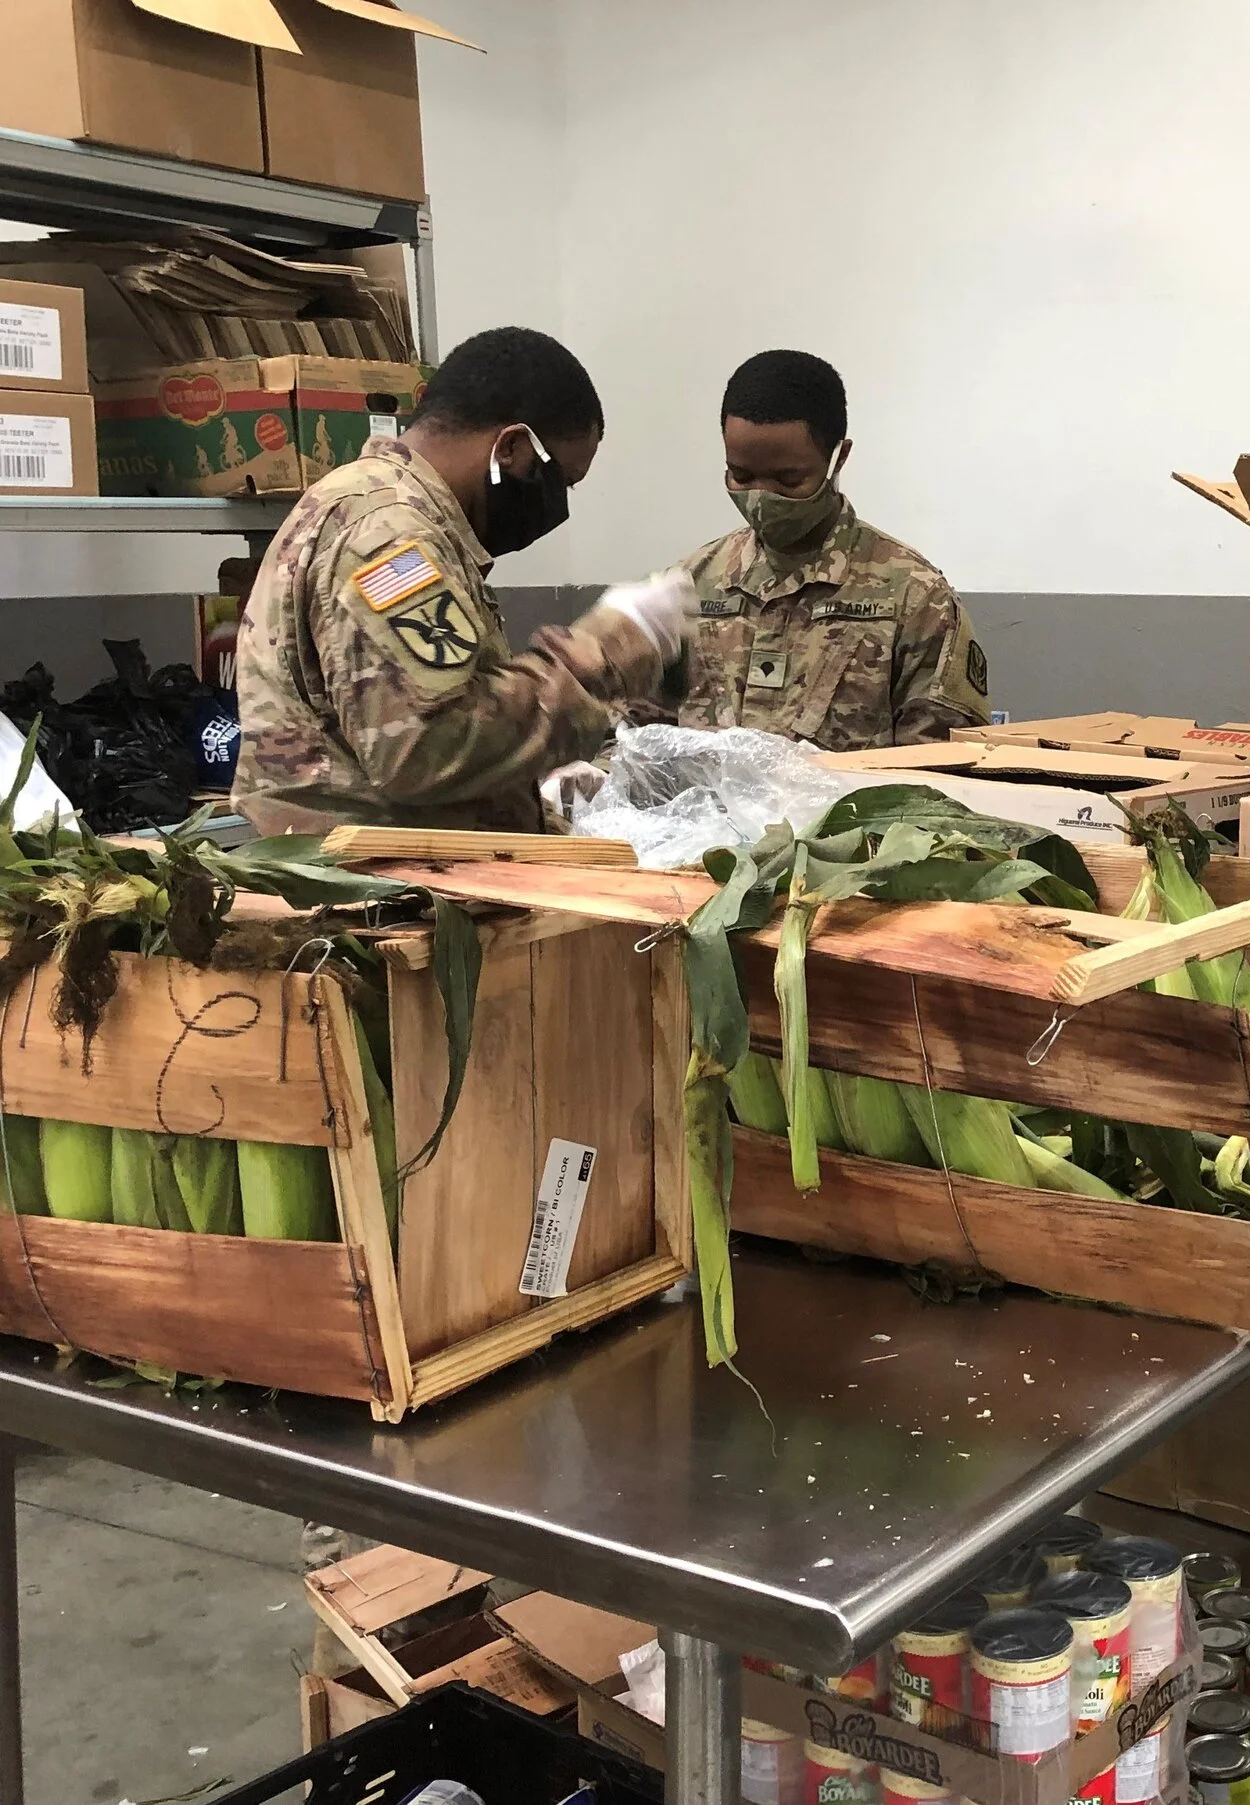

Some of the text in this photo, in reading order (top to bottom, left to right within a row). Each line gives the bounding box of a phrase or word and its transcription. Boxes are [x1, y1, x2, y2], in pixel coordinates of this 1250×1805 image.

[0, 318, 22, 326] EETER
[100, 453, 158, 476] anas
[845, 602, 879, 616] ARMY
[555, 1156, 570, 1196] COLOR
[552, 1198, 559, 1210] BI
[536, 1219, 554, 1291] SWEETCORN
[834, 1731, 943, 1786] BOYARDEE
